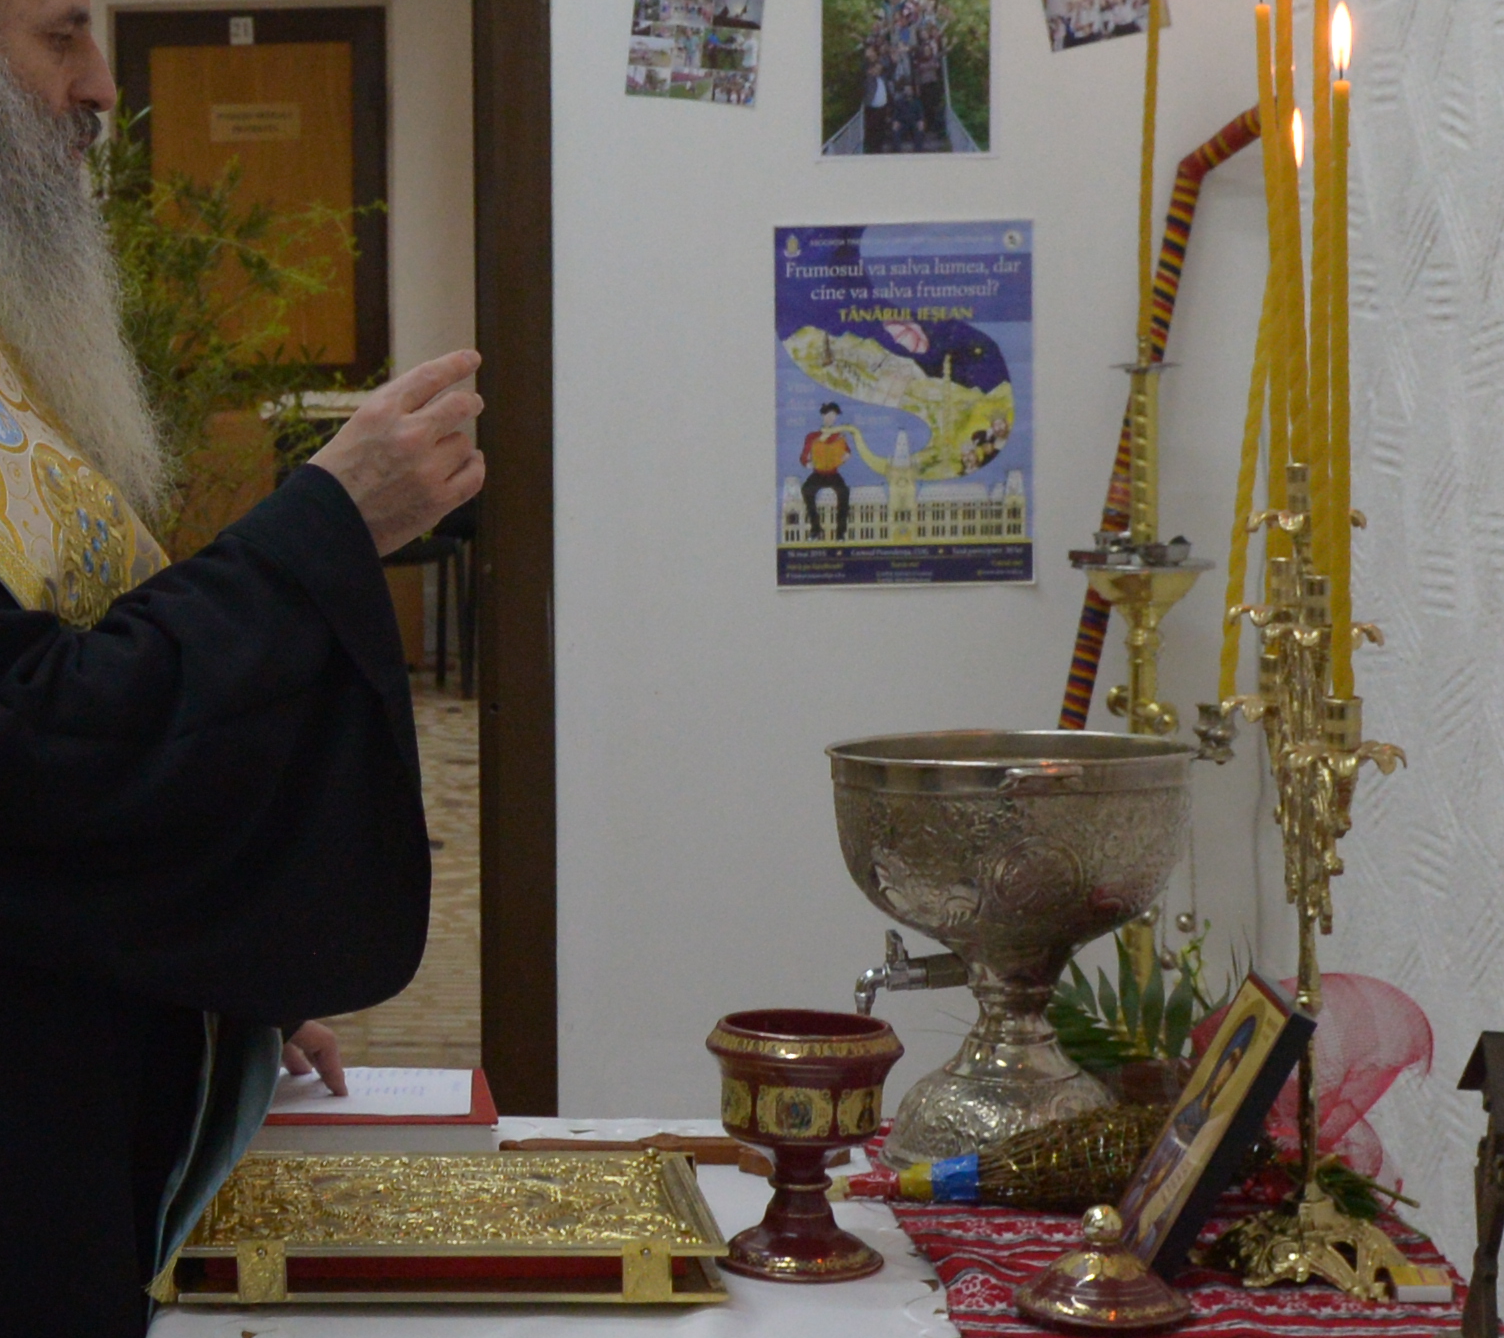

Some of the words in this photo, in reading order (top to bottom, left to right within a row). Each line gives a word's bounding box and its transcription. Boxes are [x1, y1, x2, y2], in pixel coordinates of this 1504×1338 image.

[785, 261, 865, 279] Frumosul
[868, 265, 887, 275] va
[890, 258, 930, 276] salva
[934, 257, 989, 276] lumea,
[993, 256, 1022, 274] dar
[810, 285, 846, 300] cine
[850, 287, 868, 300] va
[872, 282, 912, 299] salva
[916, 279, 1000, 298] frumosul?
